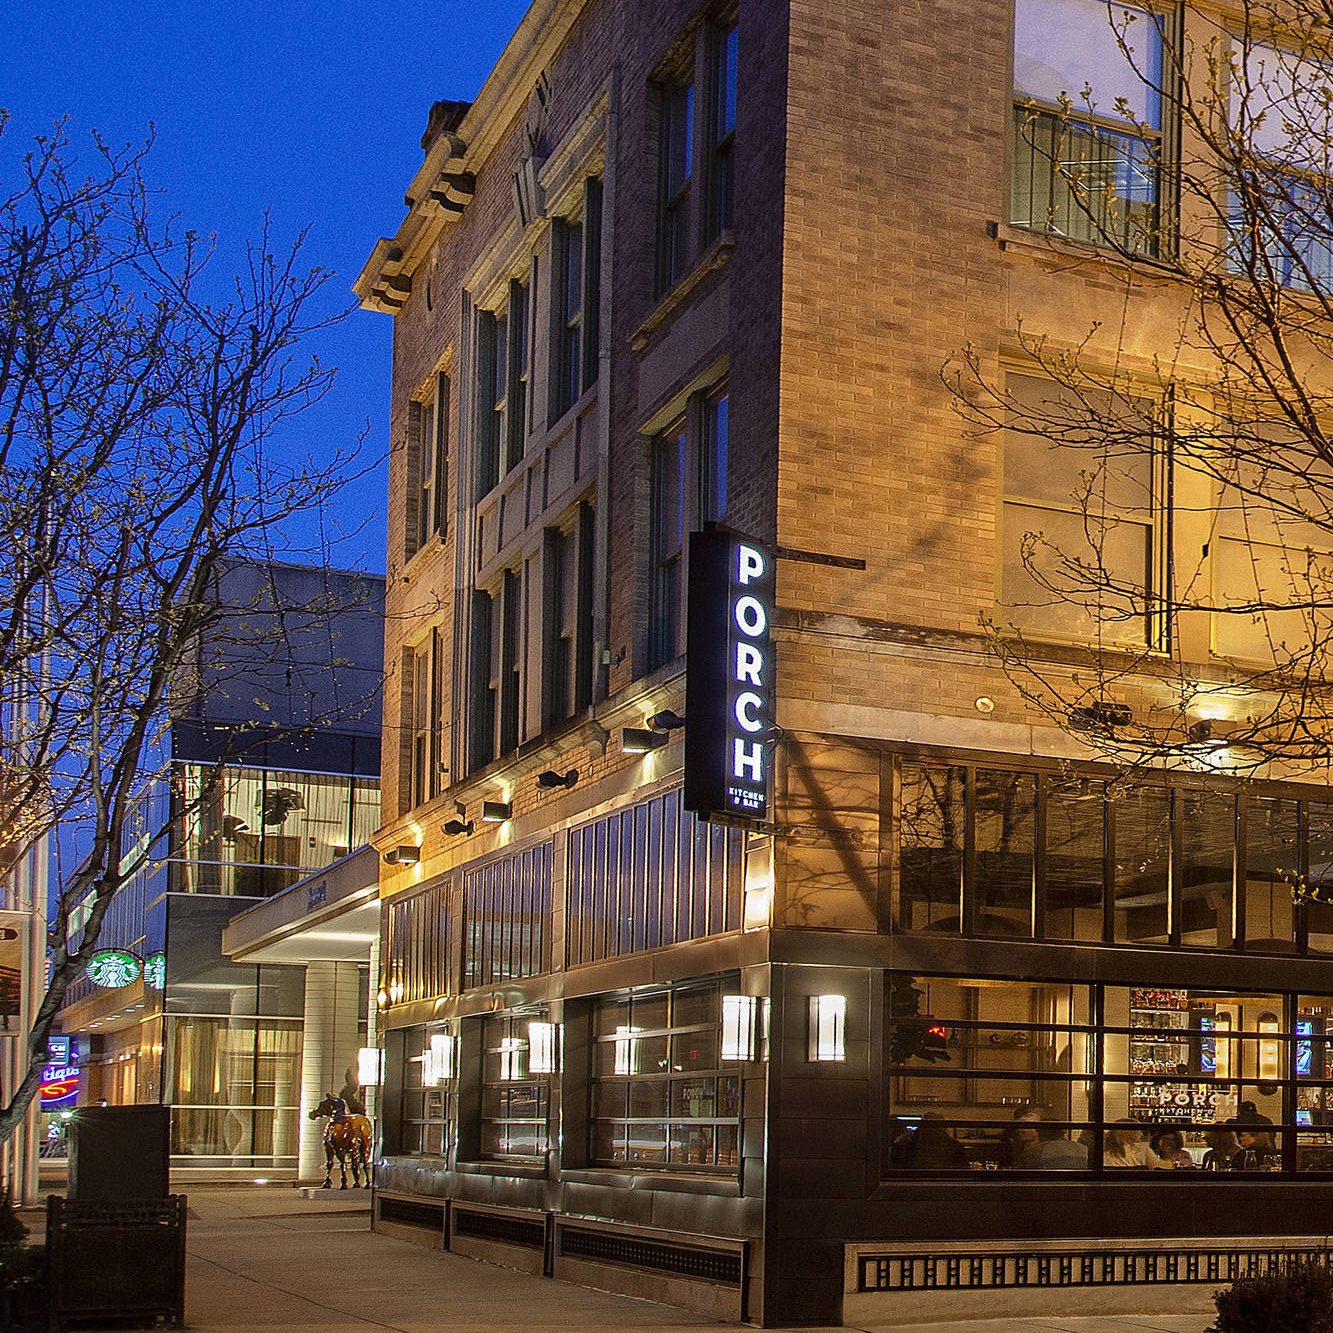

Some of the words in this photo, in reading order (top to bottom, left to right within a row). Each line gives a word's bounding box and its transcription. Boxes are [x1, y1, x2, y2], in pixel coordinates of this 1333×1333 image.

[734, 543, 767, 782] PORCH
[727, 786, 765, 802] KITCHEN
[741, 798, 760, 809] BAR
[1160, 1092, 1238, 1106] PORCH
